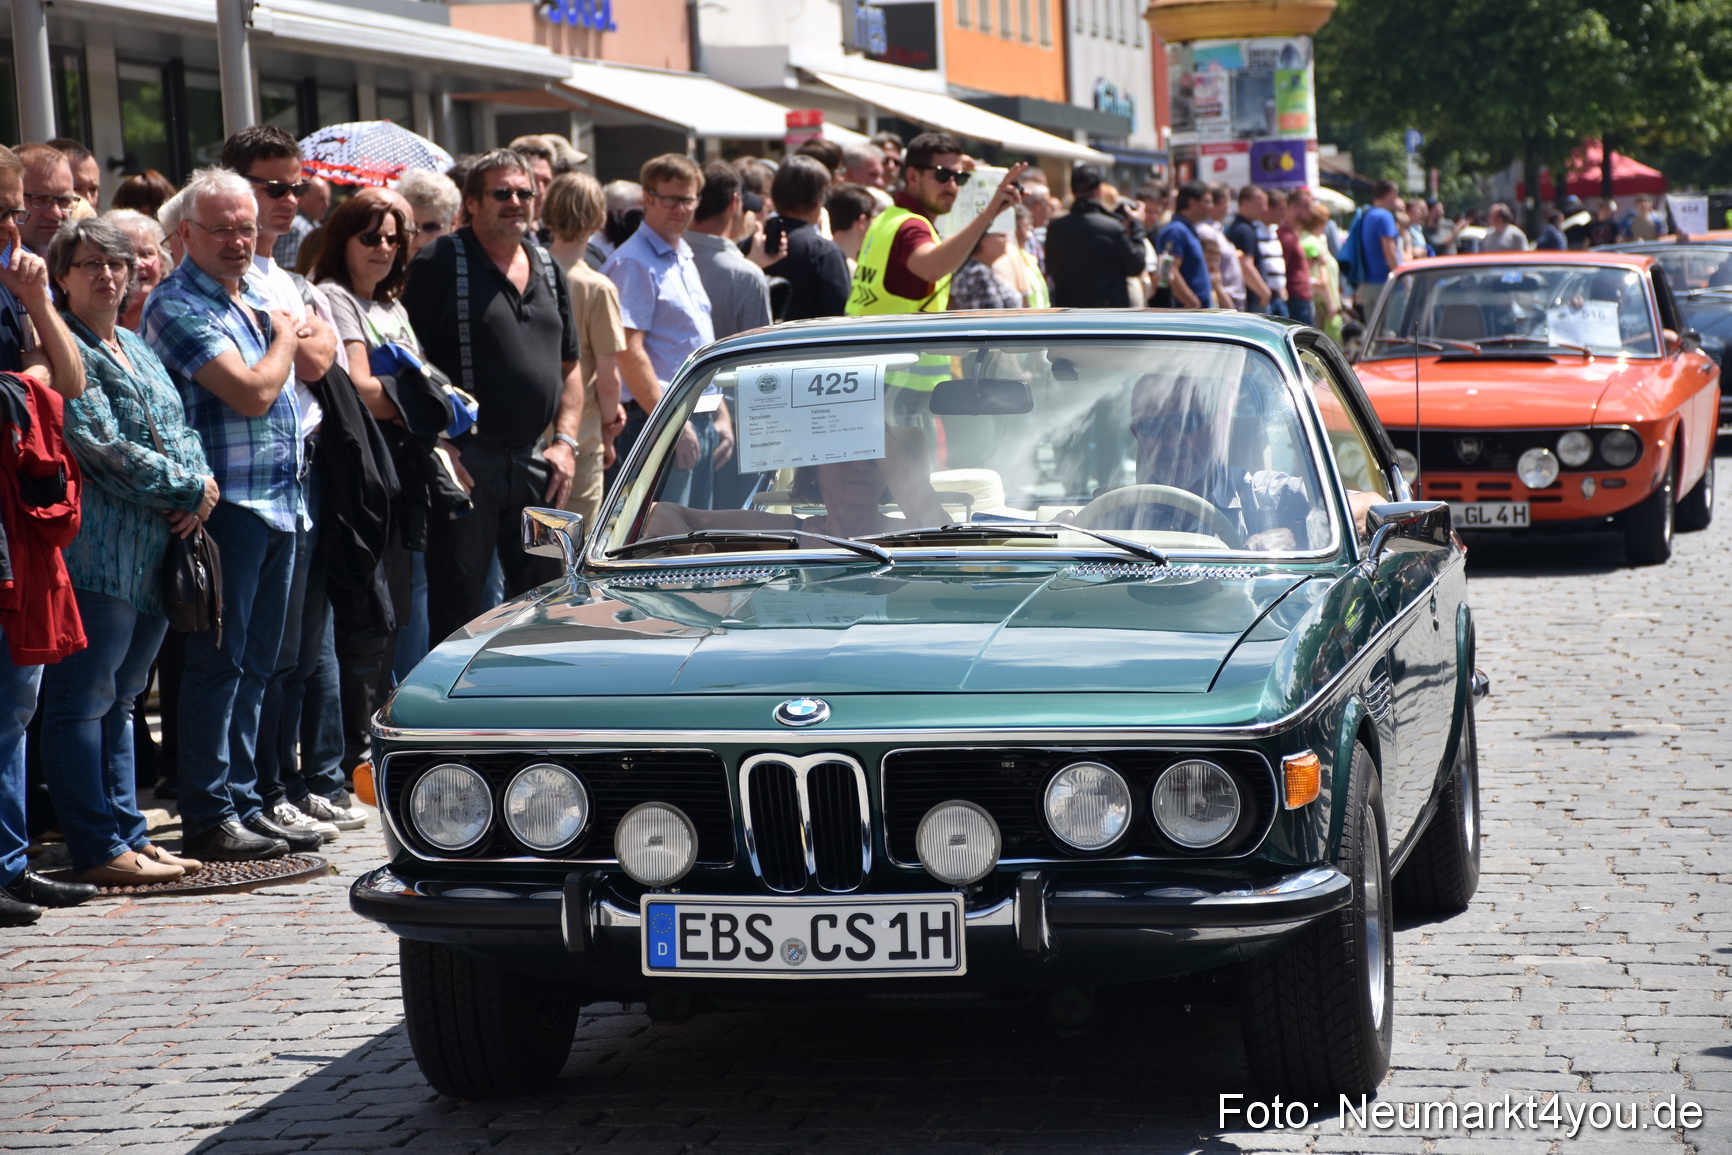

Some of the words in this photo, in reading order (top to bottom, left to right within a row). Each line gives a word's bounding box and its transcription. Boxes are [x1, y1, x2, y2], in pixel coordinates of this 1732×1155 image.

[807, 371, 859, 396] 425
[1465, 506, 1492, 524] GL
[679, 912, 774, 962] EBS
[657, 942, 668, 956] D
